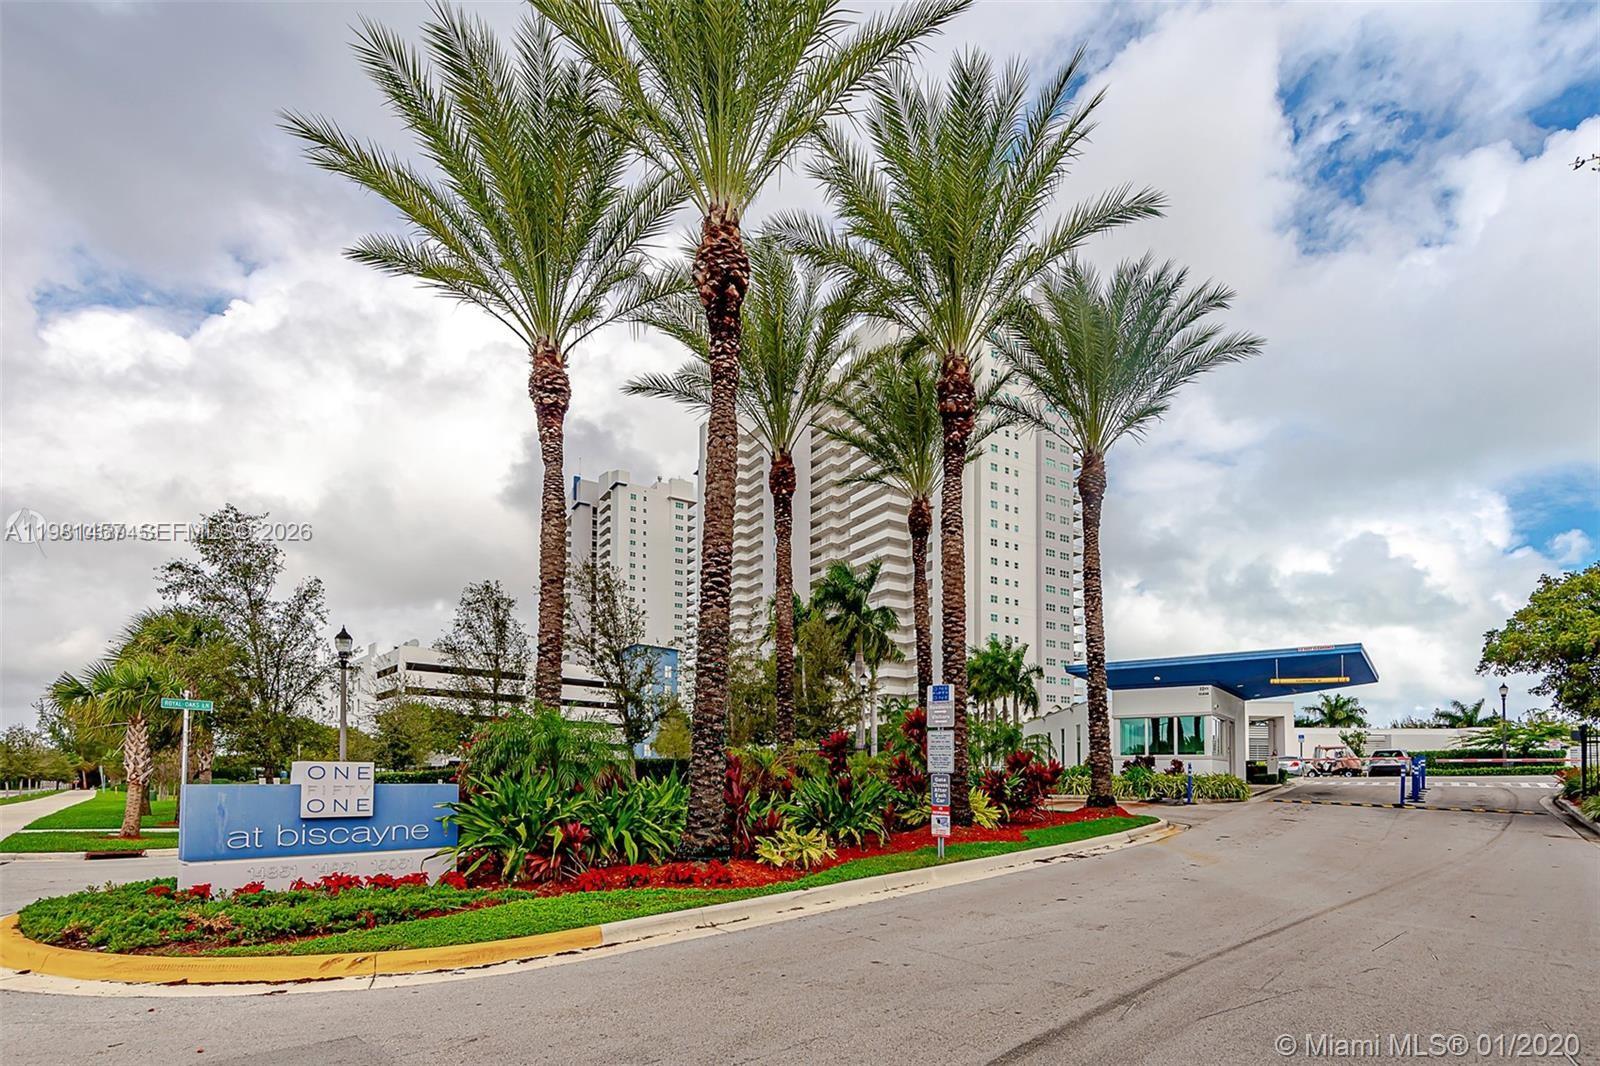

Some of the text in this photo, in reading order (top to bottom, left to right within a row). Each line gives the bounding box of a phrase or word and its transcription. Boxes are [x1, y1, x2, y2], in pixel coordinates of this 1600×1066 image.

[307, 765, 371, 780] ONE
[307, 784, 372, 796] FIFTY
[306, 798, 370, 813] ONE
[227, 823, 429, 850] at biscayne
